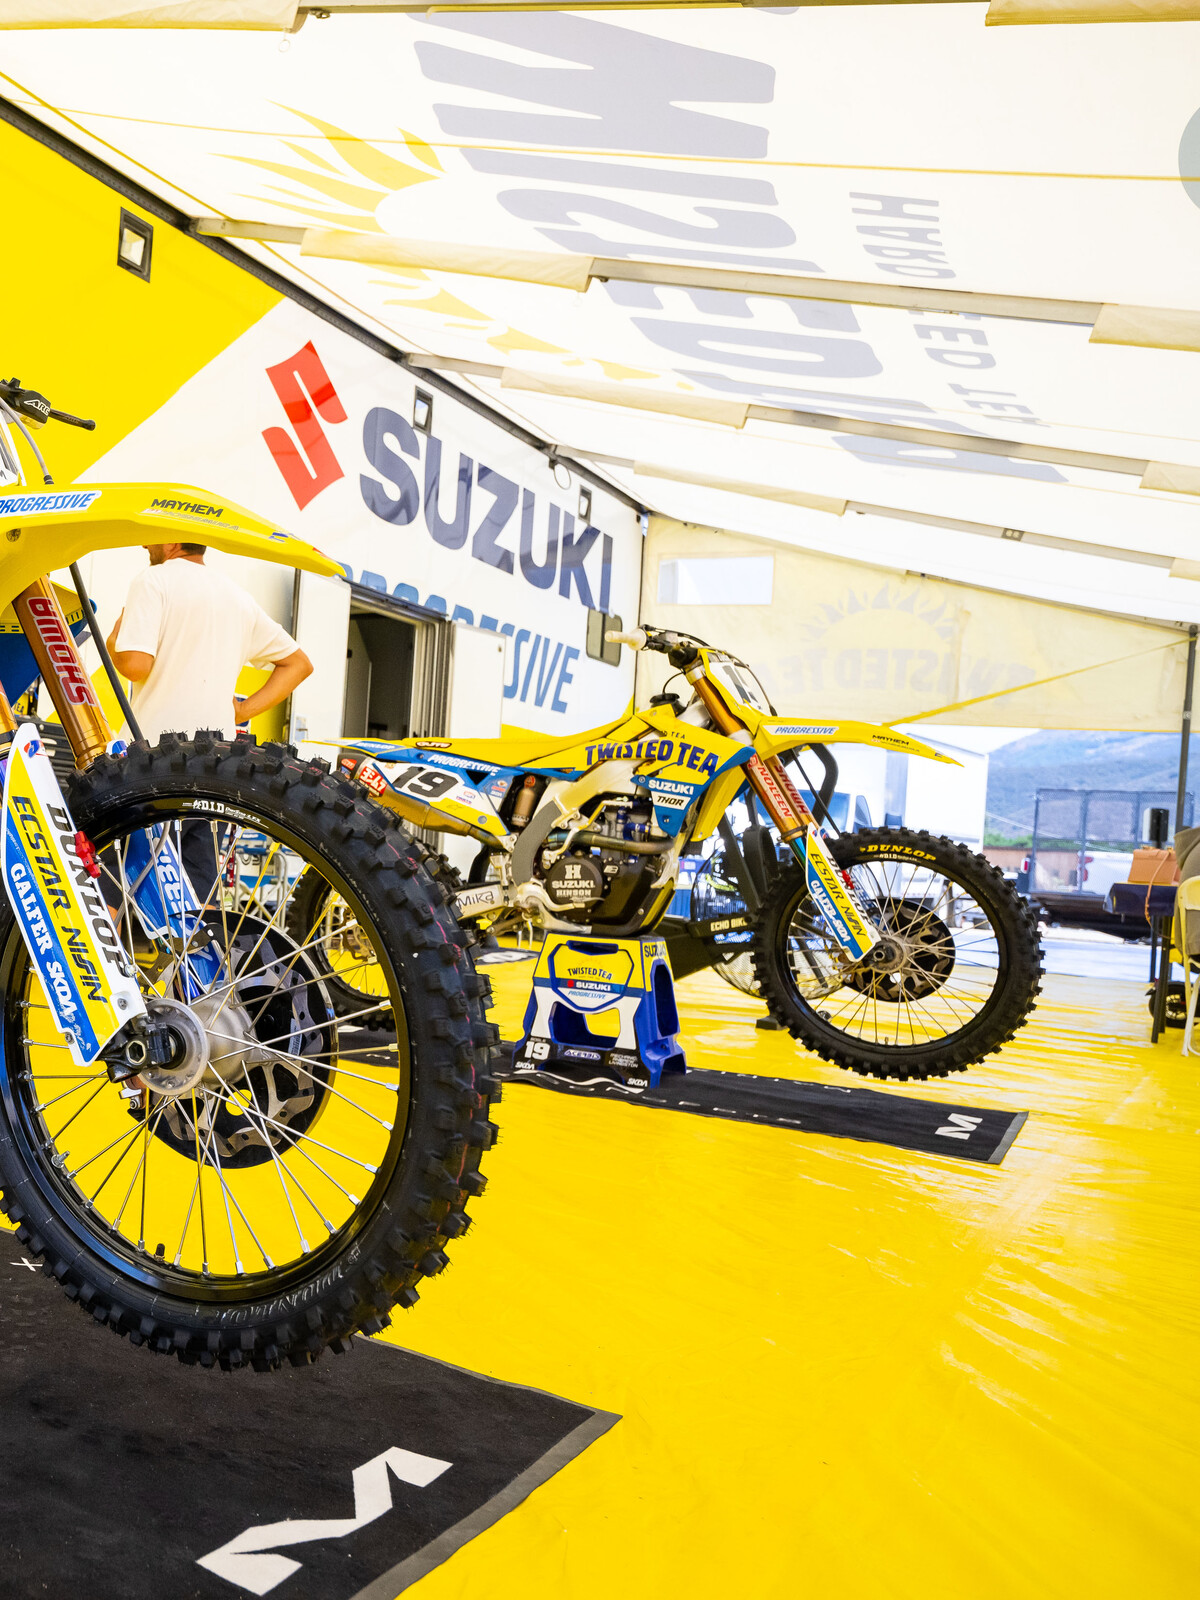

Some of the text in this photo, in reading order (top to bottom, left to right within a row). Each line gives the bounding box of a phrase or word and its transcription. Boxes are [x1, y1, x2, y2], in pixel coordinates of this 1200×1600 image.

[23, 398, 50, 416] ARC
[150, 498, 224, 518] MAYHEM
[360, 407, 613, 614] SUZUKI
[774, 726, 837, 735] PROGRESSIVE
[427, 753, 502, 776] PROGRESSIVE
[584, 739, 719, 776] TWISTED TEA
[391, 765, 460, 798] 19
[648, 779, 695, 795] SUZUKI
[656, 795, 685, 807] THOR
[757, 766, 793, 818] NOLEEN
[12, 794, 72, 918] ECSTAR
[866, 844, 937, 861] DUNLOP
[551, 880, 596, 889] SUZUKI
[810, 853, 845, 900] ECSTAR
[9, 861, 53, 956] GALFER
[567, 966, 598, 977] TWISTED
[598, 968, 613, 981] TEA
[567, 990, 607, 1000] PROGRESSIVE
[575, 981, 611, 992] SUZUKI
[524, 1041, 551, 1061] 19
[514, 1061, 535, 1070] SKDA
[627, 1077, 648, 1087] SKDA
